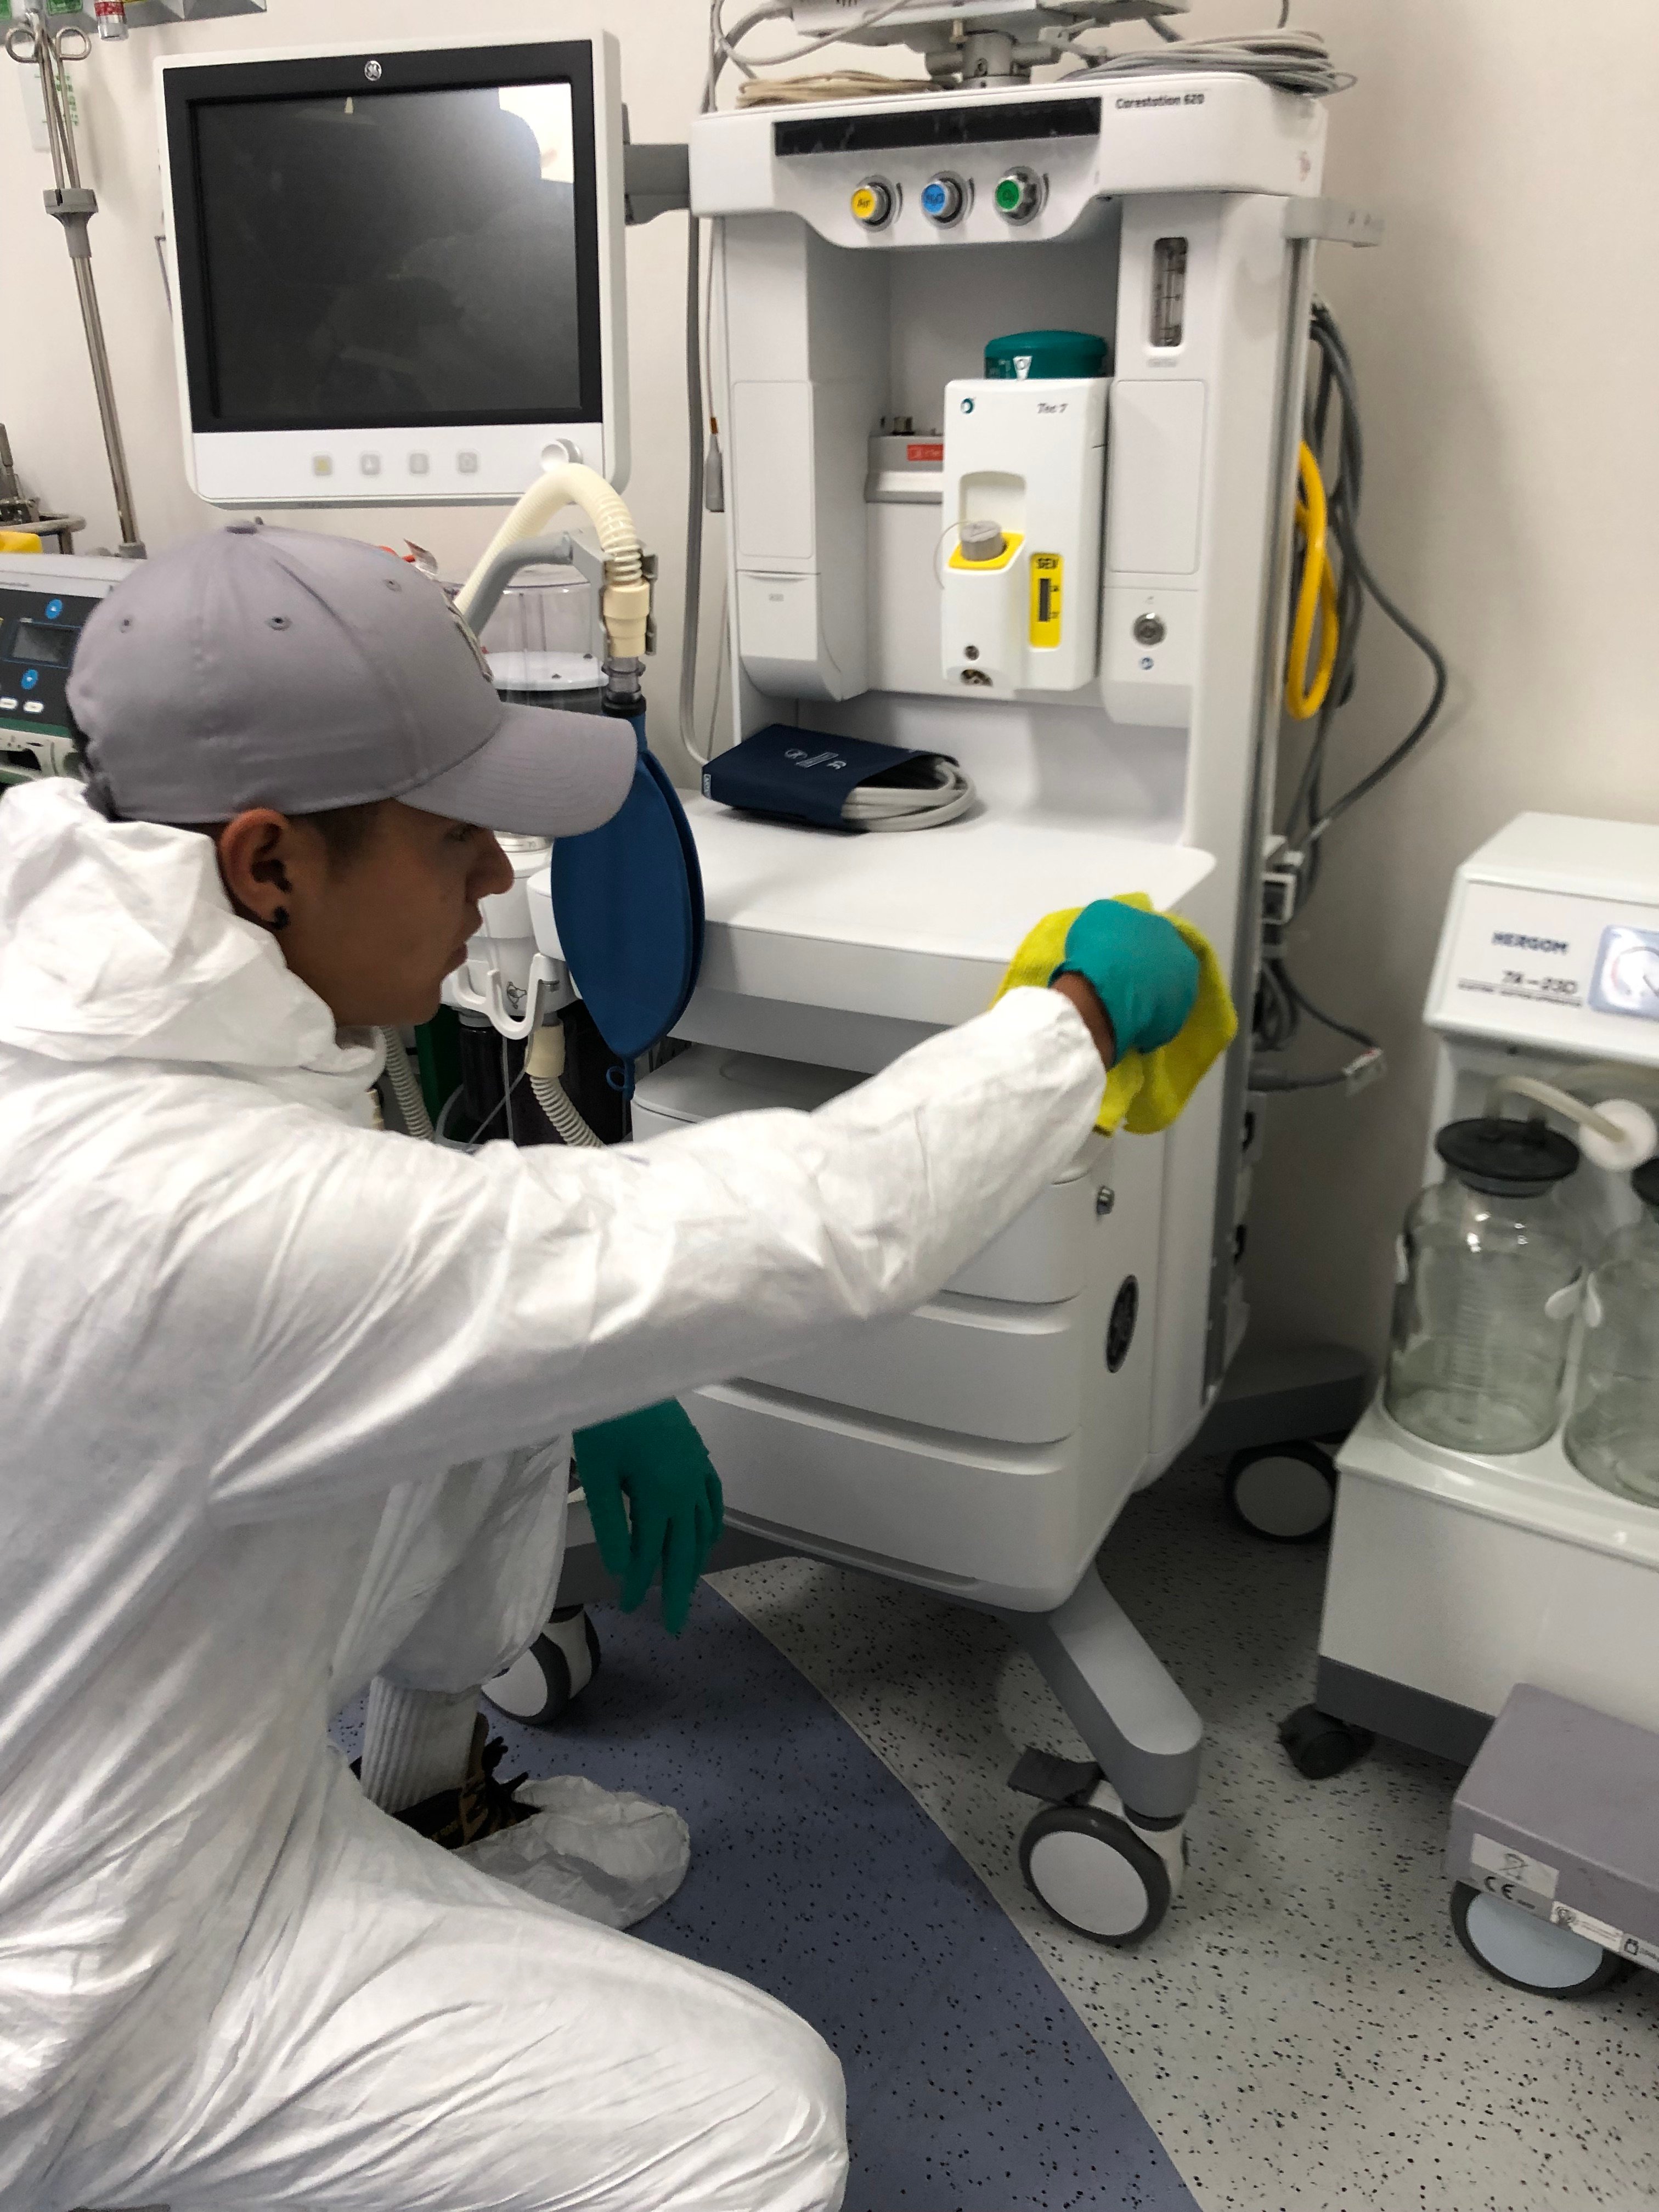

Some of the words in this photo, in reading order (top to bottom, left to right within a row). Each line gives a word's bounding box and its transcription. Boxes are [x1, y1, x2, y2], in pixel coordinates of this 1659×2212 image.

[1115, 95, 1181, 109] Carestation
[1184, 93, 1205, 105] 620
[1059, 402, 1069, 413] 7
